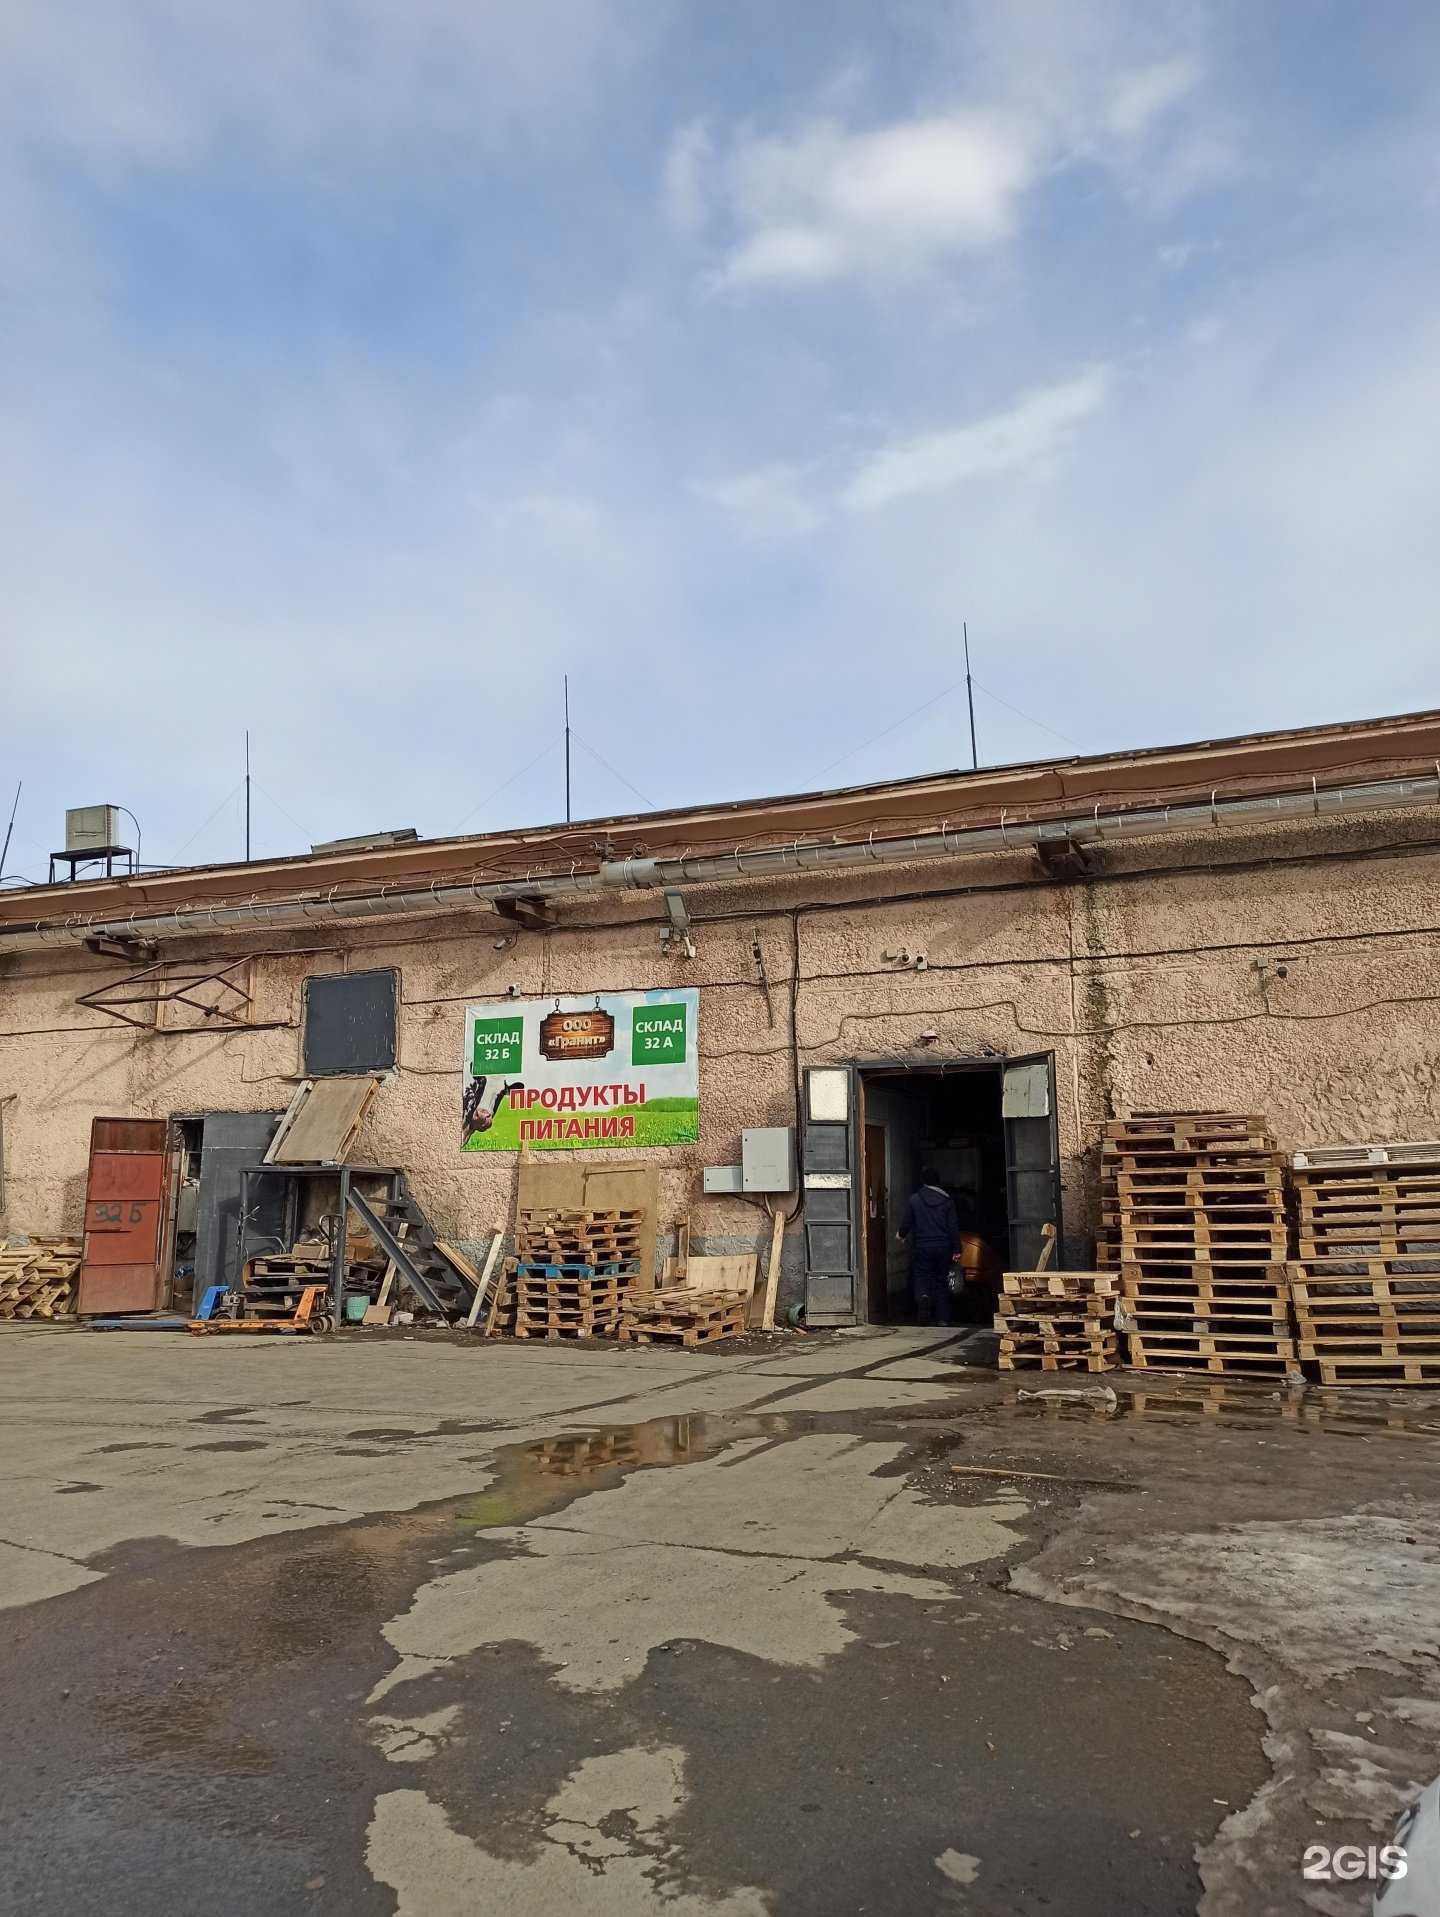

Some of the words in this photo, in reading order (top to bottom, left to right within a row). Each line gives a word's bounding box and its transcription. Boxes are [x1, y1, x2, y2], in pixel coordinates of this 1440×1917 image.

[562, 1019, 592, 1032] ООО
[635, 1019, 684, 1034] СКЛАД
[476, 1031, 521, 1046] СКЛАД
[548, 1035, 606, 1049] «Гранит»
[644, 1037, 661, 1049] 32
[662, 1038, 674, 1048] А
[484, 1048, 500, 1060] 32
[502, 1048, 511, 1059] Б
[510, 1083, 646, 1112] ПРОДУКТЫ
[519, 1116, 637, 1141] ПИТАНИЯ
